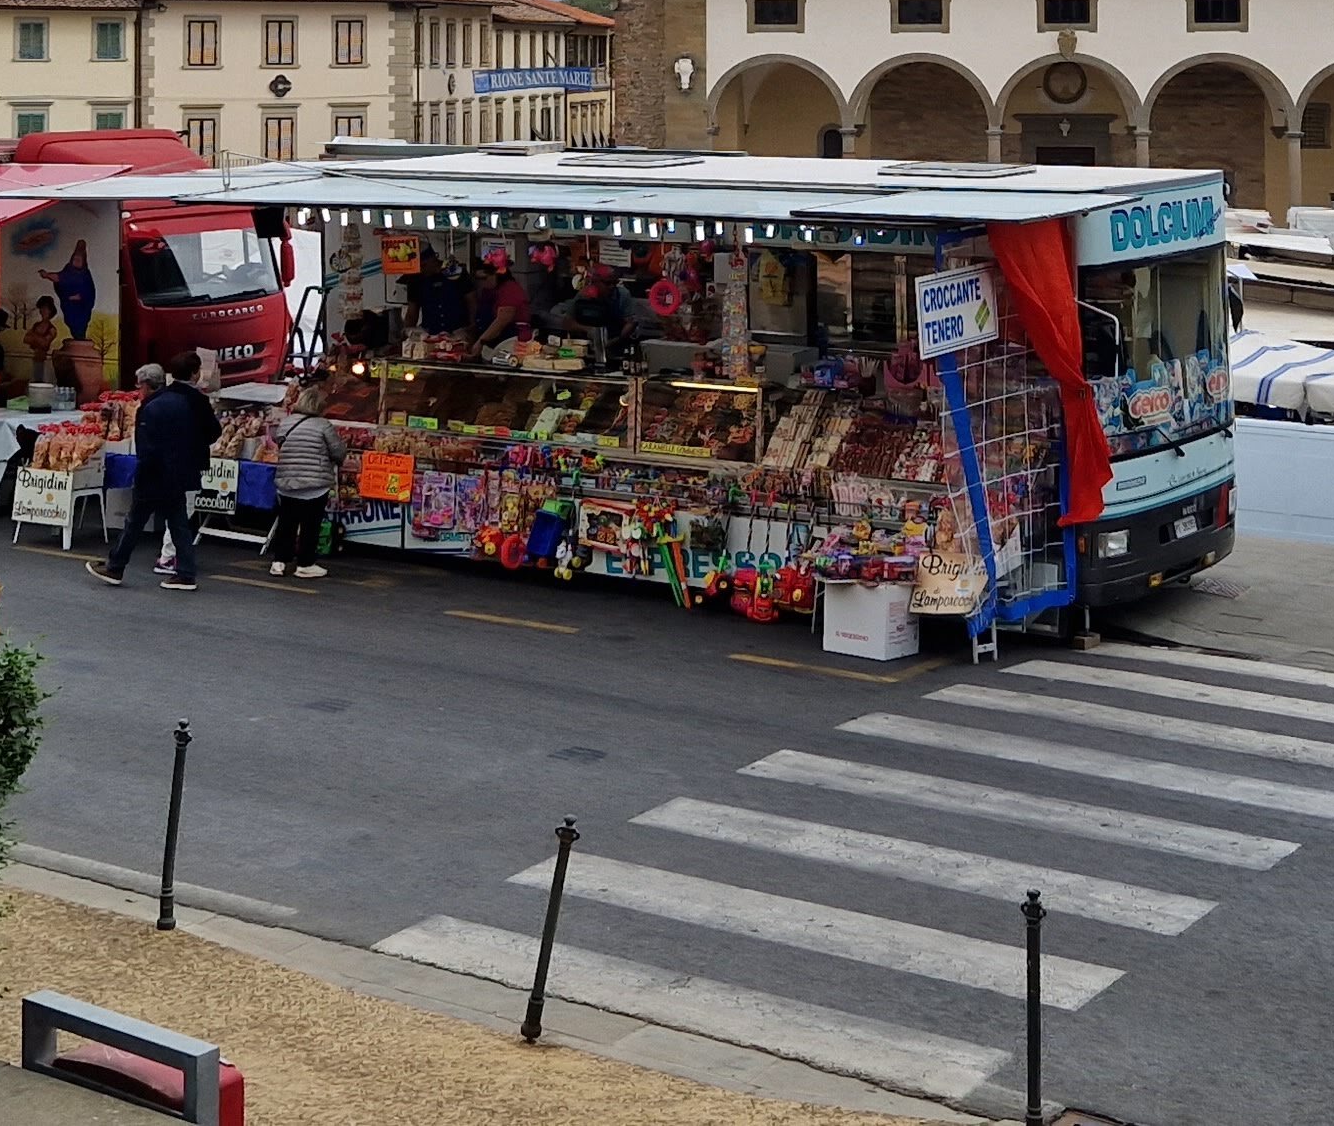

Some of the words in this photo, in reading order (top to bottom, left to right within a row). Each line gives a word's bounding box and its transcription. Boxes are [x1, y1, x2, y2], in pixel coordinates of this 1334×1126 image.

[490, 73, 524, 89] RIONE
[526, 71, 558, 86] SANTE
[560, 70, 590, 86] MARIE
[923, 277, 982, 314] CROCCANTE
[925, 314, 964, 346] TENERO
[216, 344, 254, 362] VECO
[18, 469, 68, 494] Brigidini
[201, 462, 235, 483] gidini
[195, 494, 235, 510] occolato
